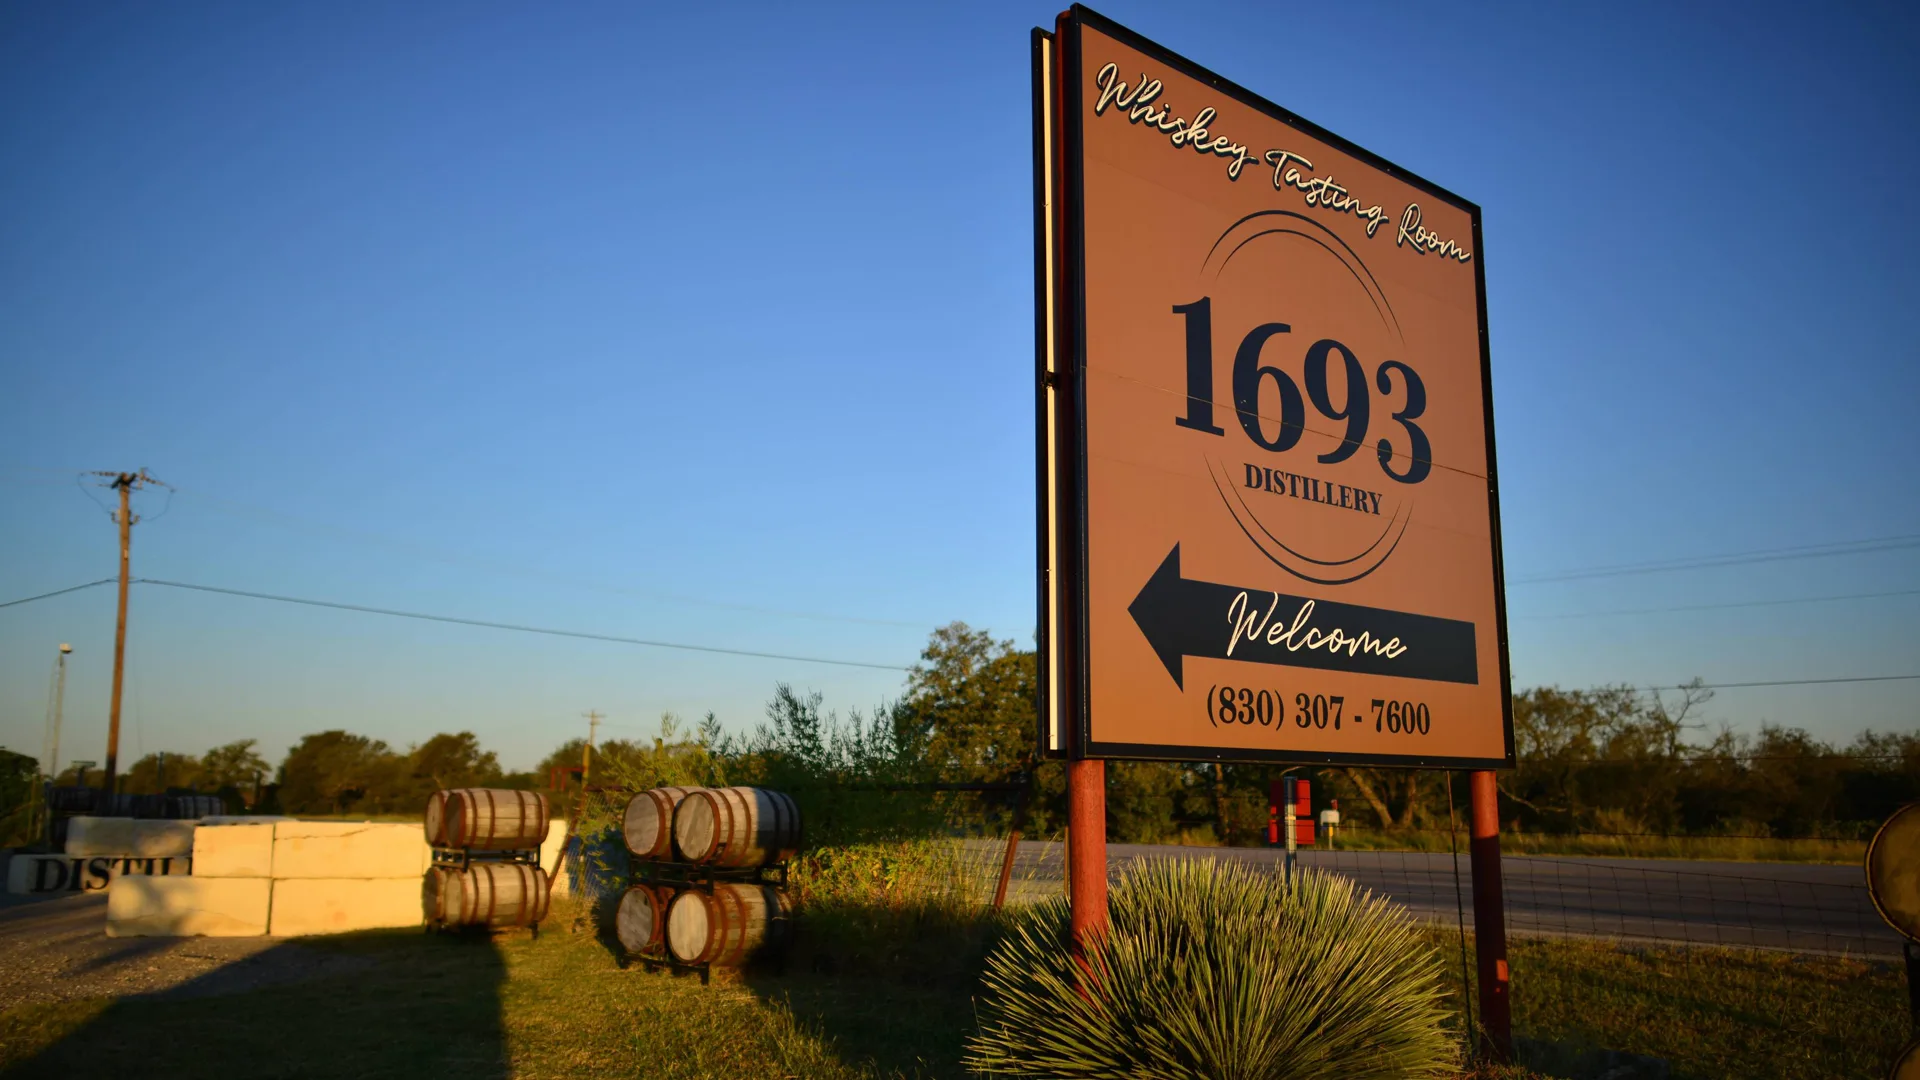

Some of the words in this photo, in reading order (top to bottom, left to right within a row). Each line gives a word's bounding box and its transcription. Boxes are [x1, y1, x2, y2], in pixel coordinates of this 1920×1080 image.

[1095, 61, 1259, 181] Whiskey
[1264, 148, 1390, 239] Tasting
[1396, 203, 1472, 263] Room
[1172, 296, 1432, 484] 1693
[1243, 463, 1383, 515] DISTILLERY
[1227, 590, 1407, 659] Welcome
[1206, 684, 1284, 731] (830)
[1295, 693, 1344, 730] 307
[1371, 698, 1431, 735] 7600
